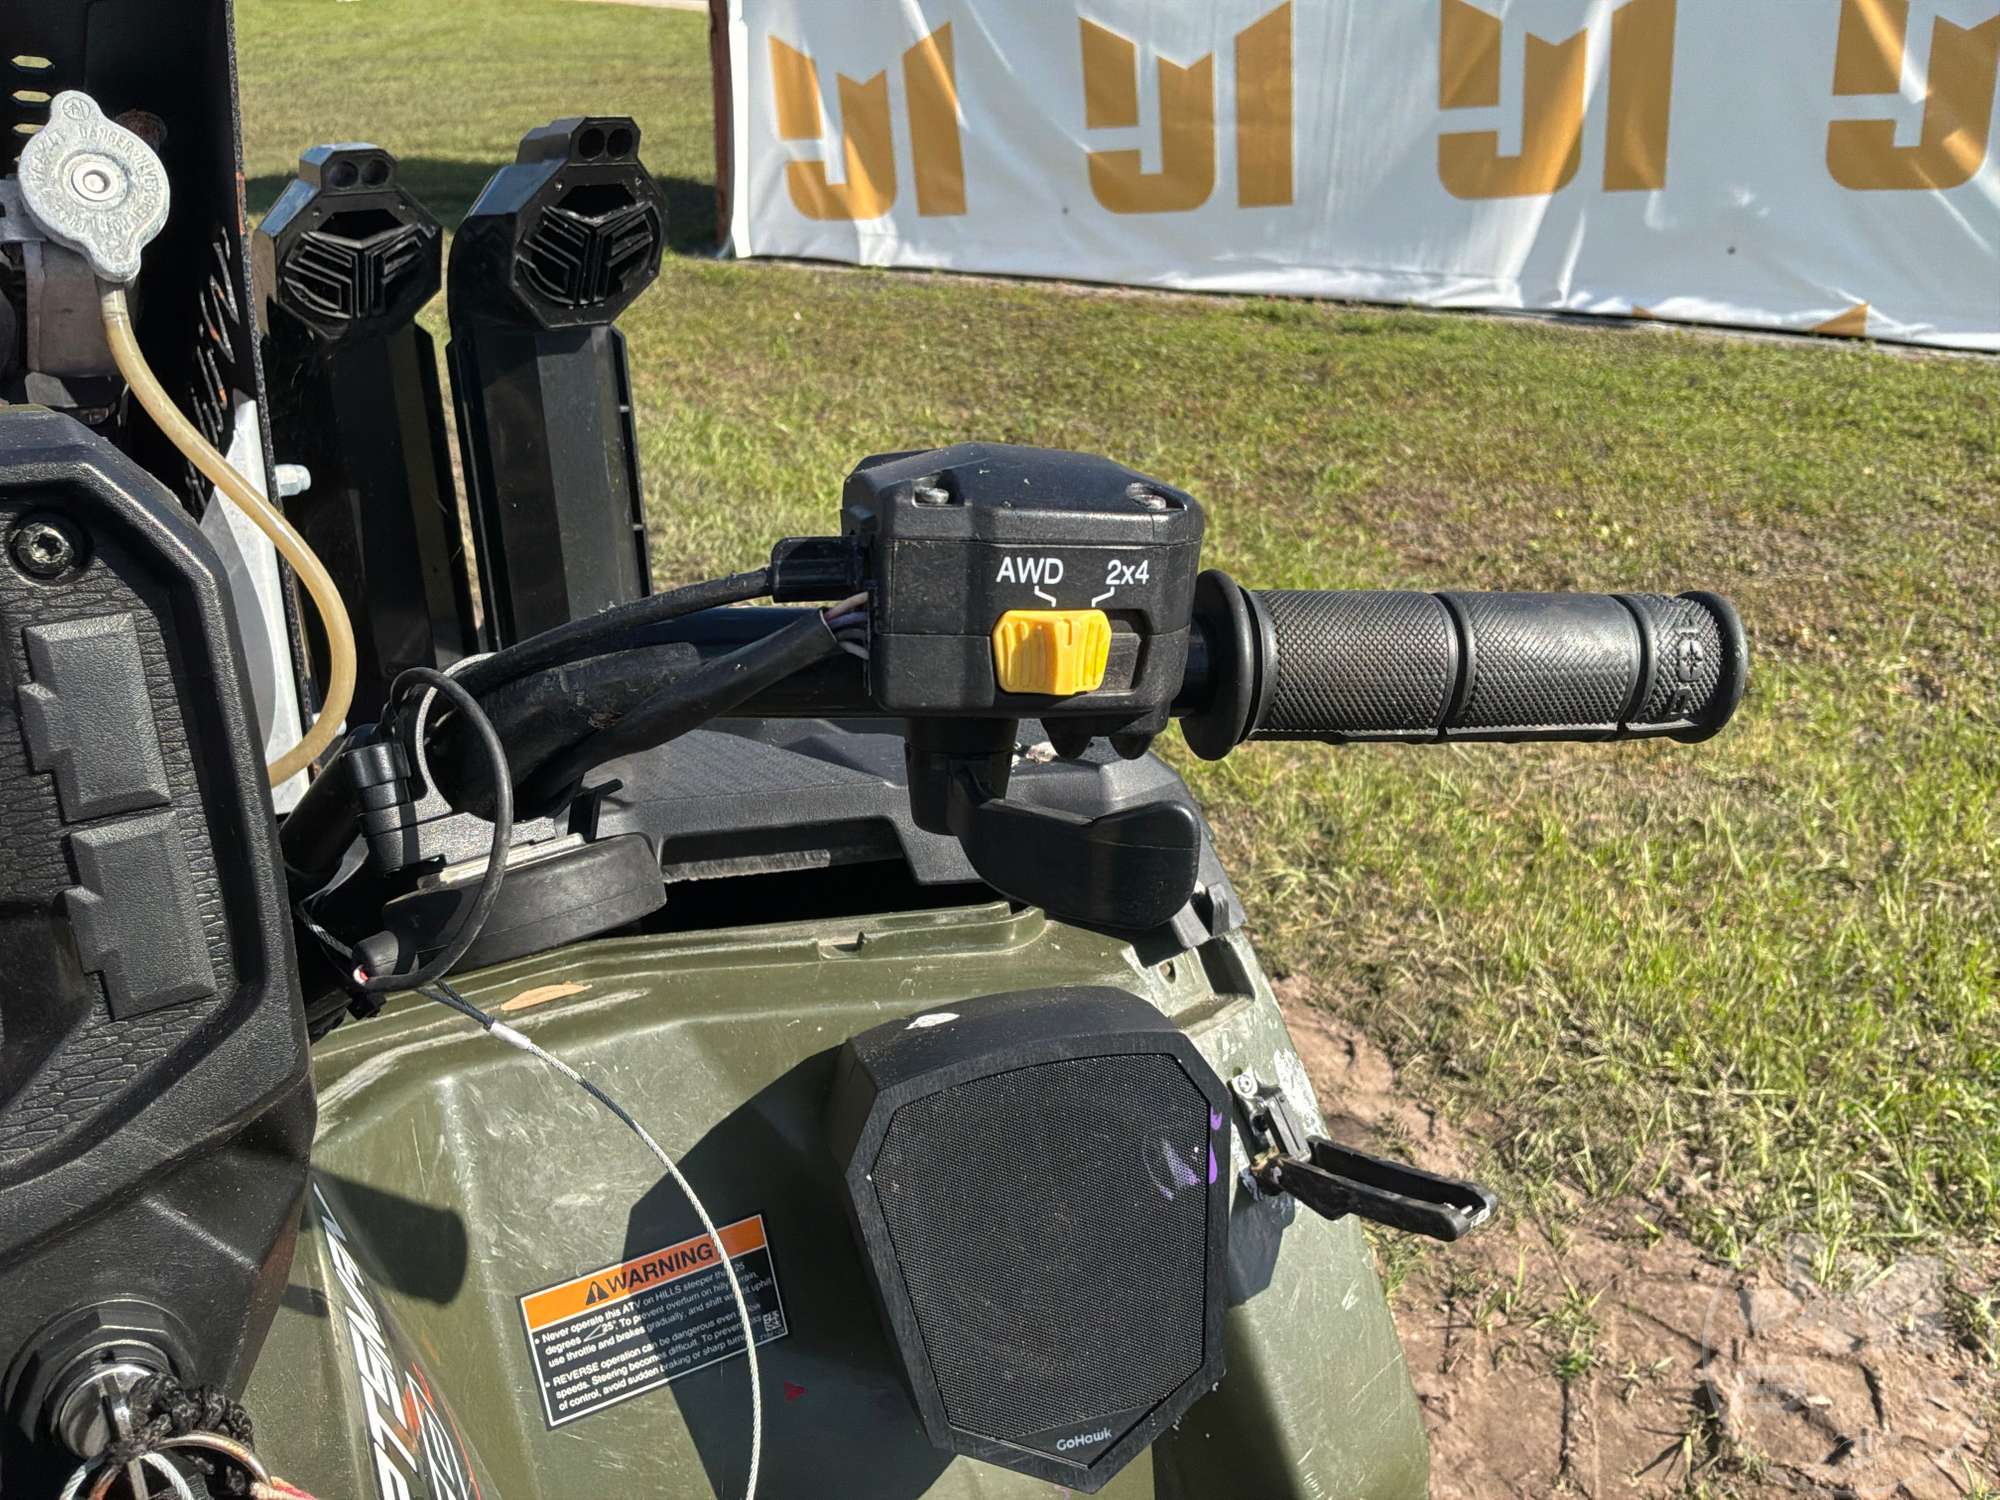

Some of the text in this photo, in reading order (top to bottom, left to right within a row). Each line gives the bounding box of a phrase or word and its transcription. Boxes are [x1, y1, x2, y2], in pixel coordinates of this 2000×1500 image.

[995, 556, 1150, 585] AWD 2x4
[606, 1243, 713, 1293] WARNING
[542, 1327, 569, 1343] Never
[571, 1315, 604, 1333] operate
[605, 1306, 621, 1322] this
[622, 1299, 641, 1314] ATV
[643, 1295, 655, 1305] on
[655, 1284, 682, 1299] HILLS
[683, 1275, 713, 1291] steeper
[545, 1336, 582, 1356] degrees
[619, 1315, 632, 1328] To
[633, 1303, 664, 1325] prevent
[666, 1293, 700, 1311] overturn
[701, 1288, 713, 1298] on
[713, 1281, 729, 1294] hilly
[548, 1357, 565, 1368] use
[566, 1344, 596, 1362] throttle
[598, 1337, 615, 1349] and
[616, 1325, 646, 1342] brakes
[647, 1310, 687, 1333] gradually,
[688, 1302, 704, 1316] and
[705, 1296, 723, 1310] shift
[552, 1361, 599, 1387] REVERSE
[601, 1348, 641, 1369] operation
[642, 1342, 658, 1353] can
[658, 1334, 670, 1346] be
[671, 1318, 715, 1341] dangerous
[716, 1311, 737, 1323] even
[556, 1382, 590, 1400] speeds.
[591, 1366, 628, 1386] Steering
[628, 1351, 667, 1372] becomes
[701, 1332, 712, 1343] To
[713, 1320, 743, 1339] preven
[559, 1399, 569, 1412] of
[570, 1391, 602, 1408] control,
[603, 1377, 627, 1394] avoid
[628, 1366, 659, 1388] sudden
[660, 1352, 692, 1372] braking
[692, 1350, 701, 1360] or
[702, 1341, 726, 1357] sharp
[1056, 1427, 1113, 1451] GoHawk
